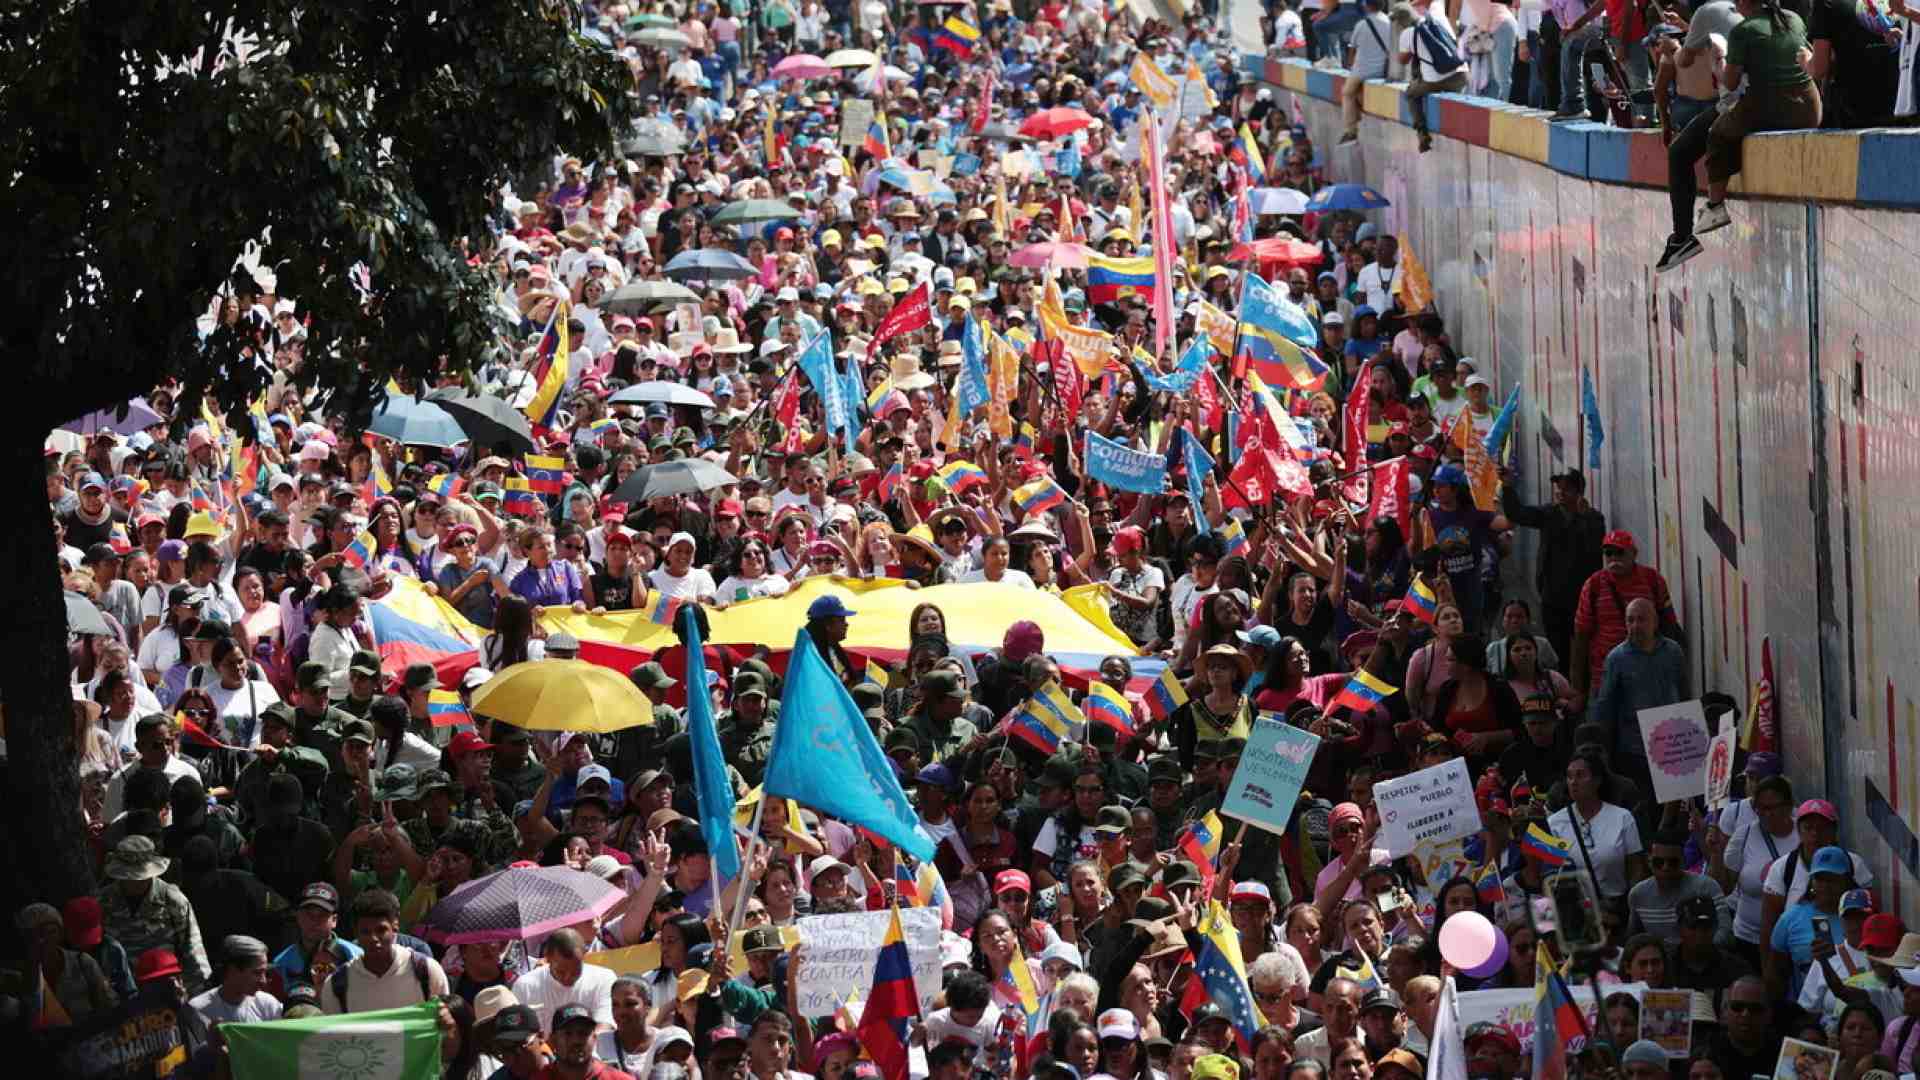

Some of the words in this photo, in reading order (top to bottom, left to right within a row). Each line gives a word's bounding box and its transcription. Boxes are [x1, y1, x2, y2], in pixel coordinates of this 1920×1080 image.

[1380, 783, 1421, 801] RESPETEN
[1433, 777, 1440, 788] A
[1420, 786, 1453, 804] PUEBLO
[1447, 808, 1454, 817] A
[800, 963, 865, 983] CONTRA
